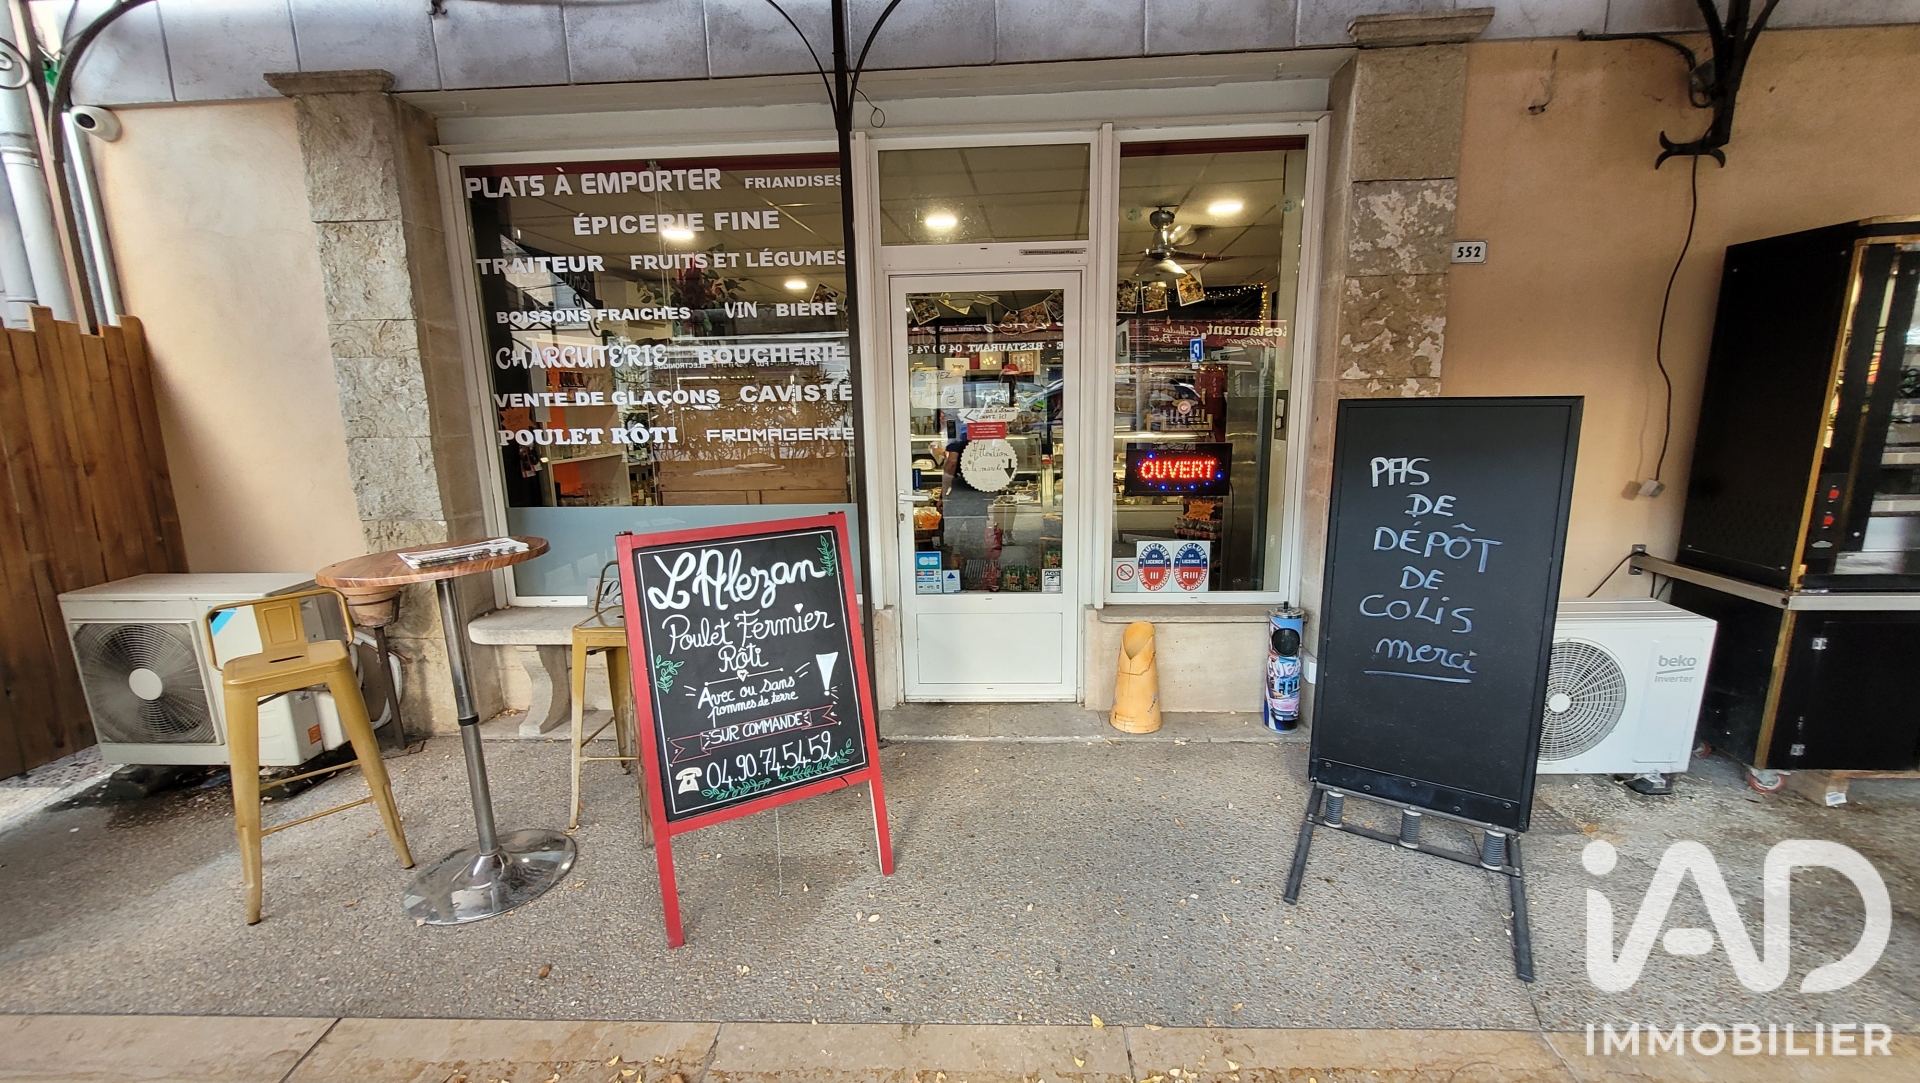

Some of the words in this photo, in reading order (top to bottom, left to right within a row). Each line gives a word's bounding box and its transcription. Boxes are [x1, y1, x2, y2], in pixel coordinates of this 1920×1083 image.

[465, 174, 545, 199] PLATS
[553, 166, 574, 196] À
[580, 168, 722, 195] EMPORTER
[744, 173, 842, 190] FRIANDISES
[573, 212, 705, 236] ÉPICERIE
[713, 210, 780, 232] FINE
[630, 253, 708, 271] FRUITS
[713, 252, 739, 268] ET
[745, 247, 847, 268] LÉGUMES
[1457, 246, 1481, 258] 552
[475, 255, 605, 275] TRAITEUR
[496, 308, 592, 324] BOISSONS
[597, 306, 692, 322] FRAICHES
[724, 300, 758, 319] VIN
[775, 299, 838, 317] BIÈRE
[495, 344, 668, 370] CHARCUTERIE
[698, 345, 847, 364] BOUCHERIE
[494, 392, 569, 408] VENTE
[574, 391, 605, 407] DE
[611, 388, 721, 409] GLAÇONS
[739, 384, 853, 403] CAVISTE
[498, 427, 604, 446] POULET
[611, 421, 678, 444] RÔTI
[706, 426, 855, 443] FROMAGERIE
[969, 440, 1009, 461] Attention
[1141, 460, 1216, 479] OUVERT
[1370, 457, 1431, 488] PAS
[1404, 494, 1457, 517] DE
[1139, 543, 1171, 560] VAUCLUSE
[1175, 543, 1207, 560] VAUCLUSE
[1373, 520, 1503, 573] DÉPÔT
[918, 556, 939, 566] CB
[1150, 572, 1159, 580] III
[1182, 571, 1199, 579] RIII
[1399, 565, 1445, 590] DE
[661, 614, 734, 655] Poulet
[733, 606, 836, 648] Fermier
[718, 642, 769, 674] Rôti
[1375, 637, 1478, 674] merci
[1658, 654, 1698, 668] beko
[697, 685, 736, 709] Avec
[739, 684, 758, 699] ou
[759, 676, 796, 695] sans
[709, 699, 757, 728] pommes
[757, 693, 770, 708] de
[770, 689, 799, 705] terre
[709, 725, 740, 745] SUR
[741, 711, 803, 738] COMMANDE
[705, 730, 837, 787] 04.90.74.54.52
